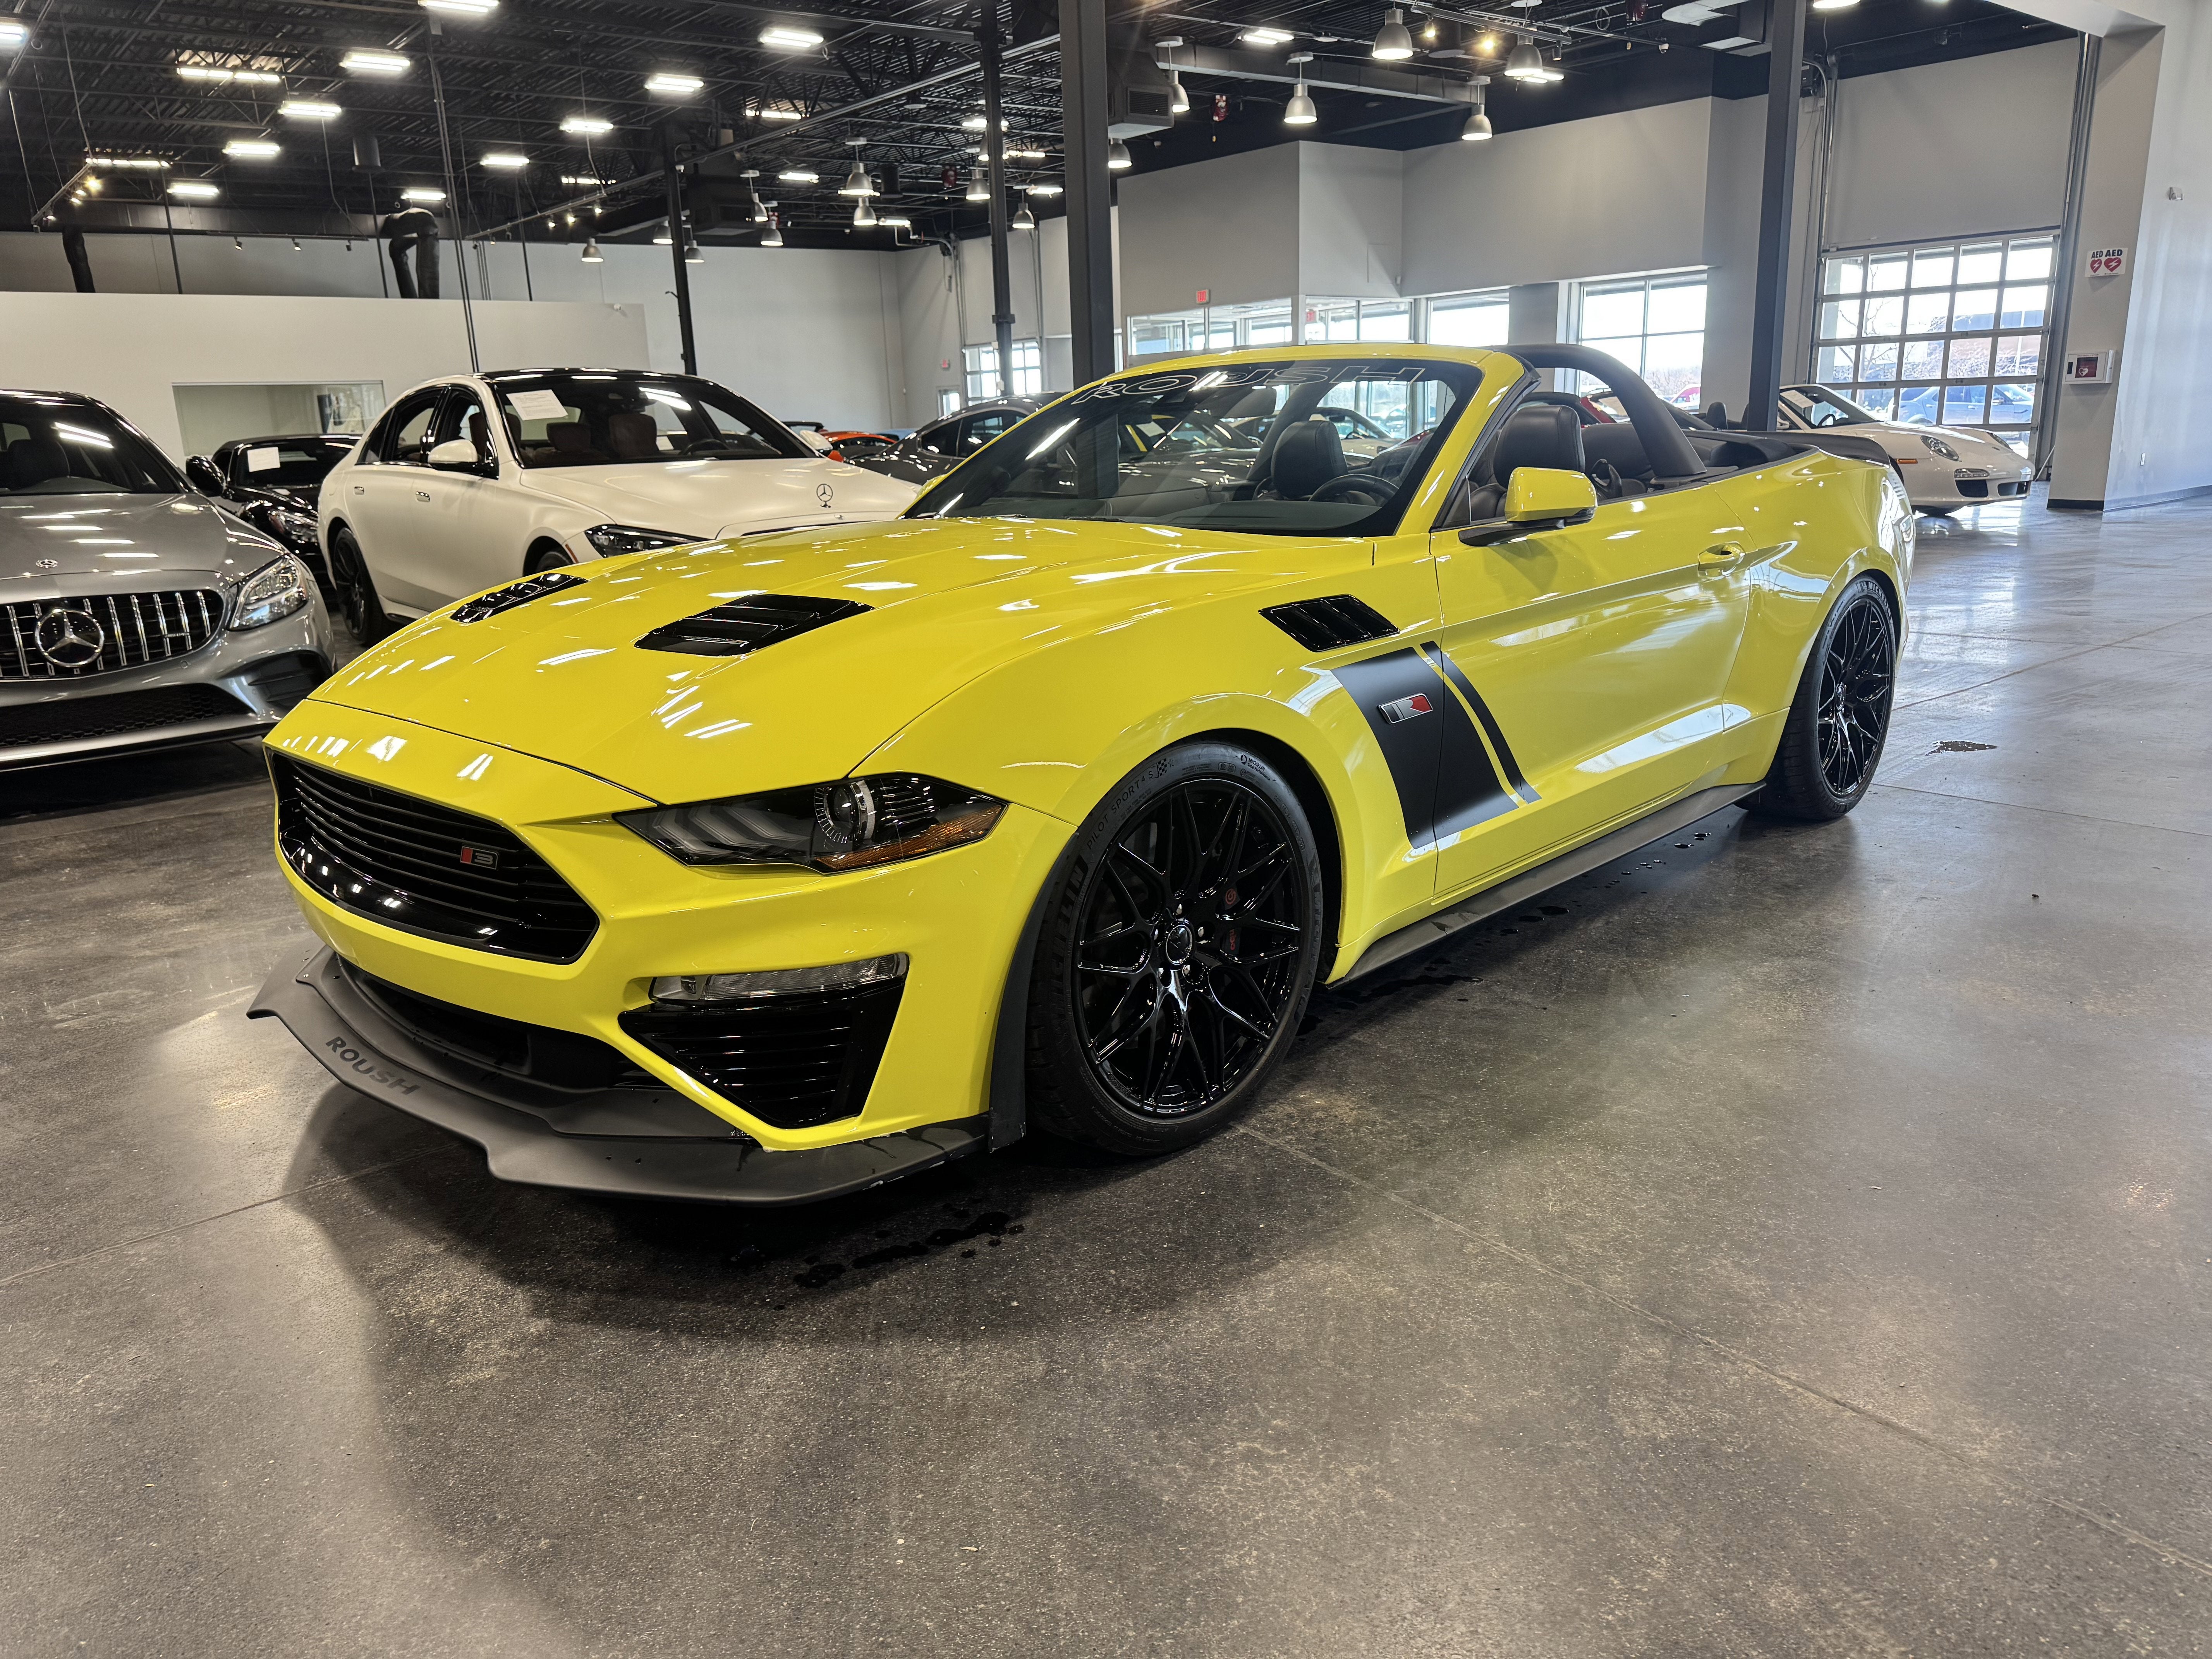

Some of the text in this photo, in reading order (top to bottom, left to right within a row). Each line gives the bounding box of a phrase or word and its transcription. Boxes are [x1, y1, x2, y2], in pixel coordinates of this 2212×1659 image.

[2091, 249, 2123, 259] AED AED
[1071, 366, 1425, 405] ROUSH
[1248, 758, 1266, 771] MICHELIN
[1086, 813, 1109, 850] PILOT
[1111, 780, 1140, 814] SPORT
[1148, 770, 1153, 779] S
[325, 1036, 422, 1095] ROUSH
